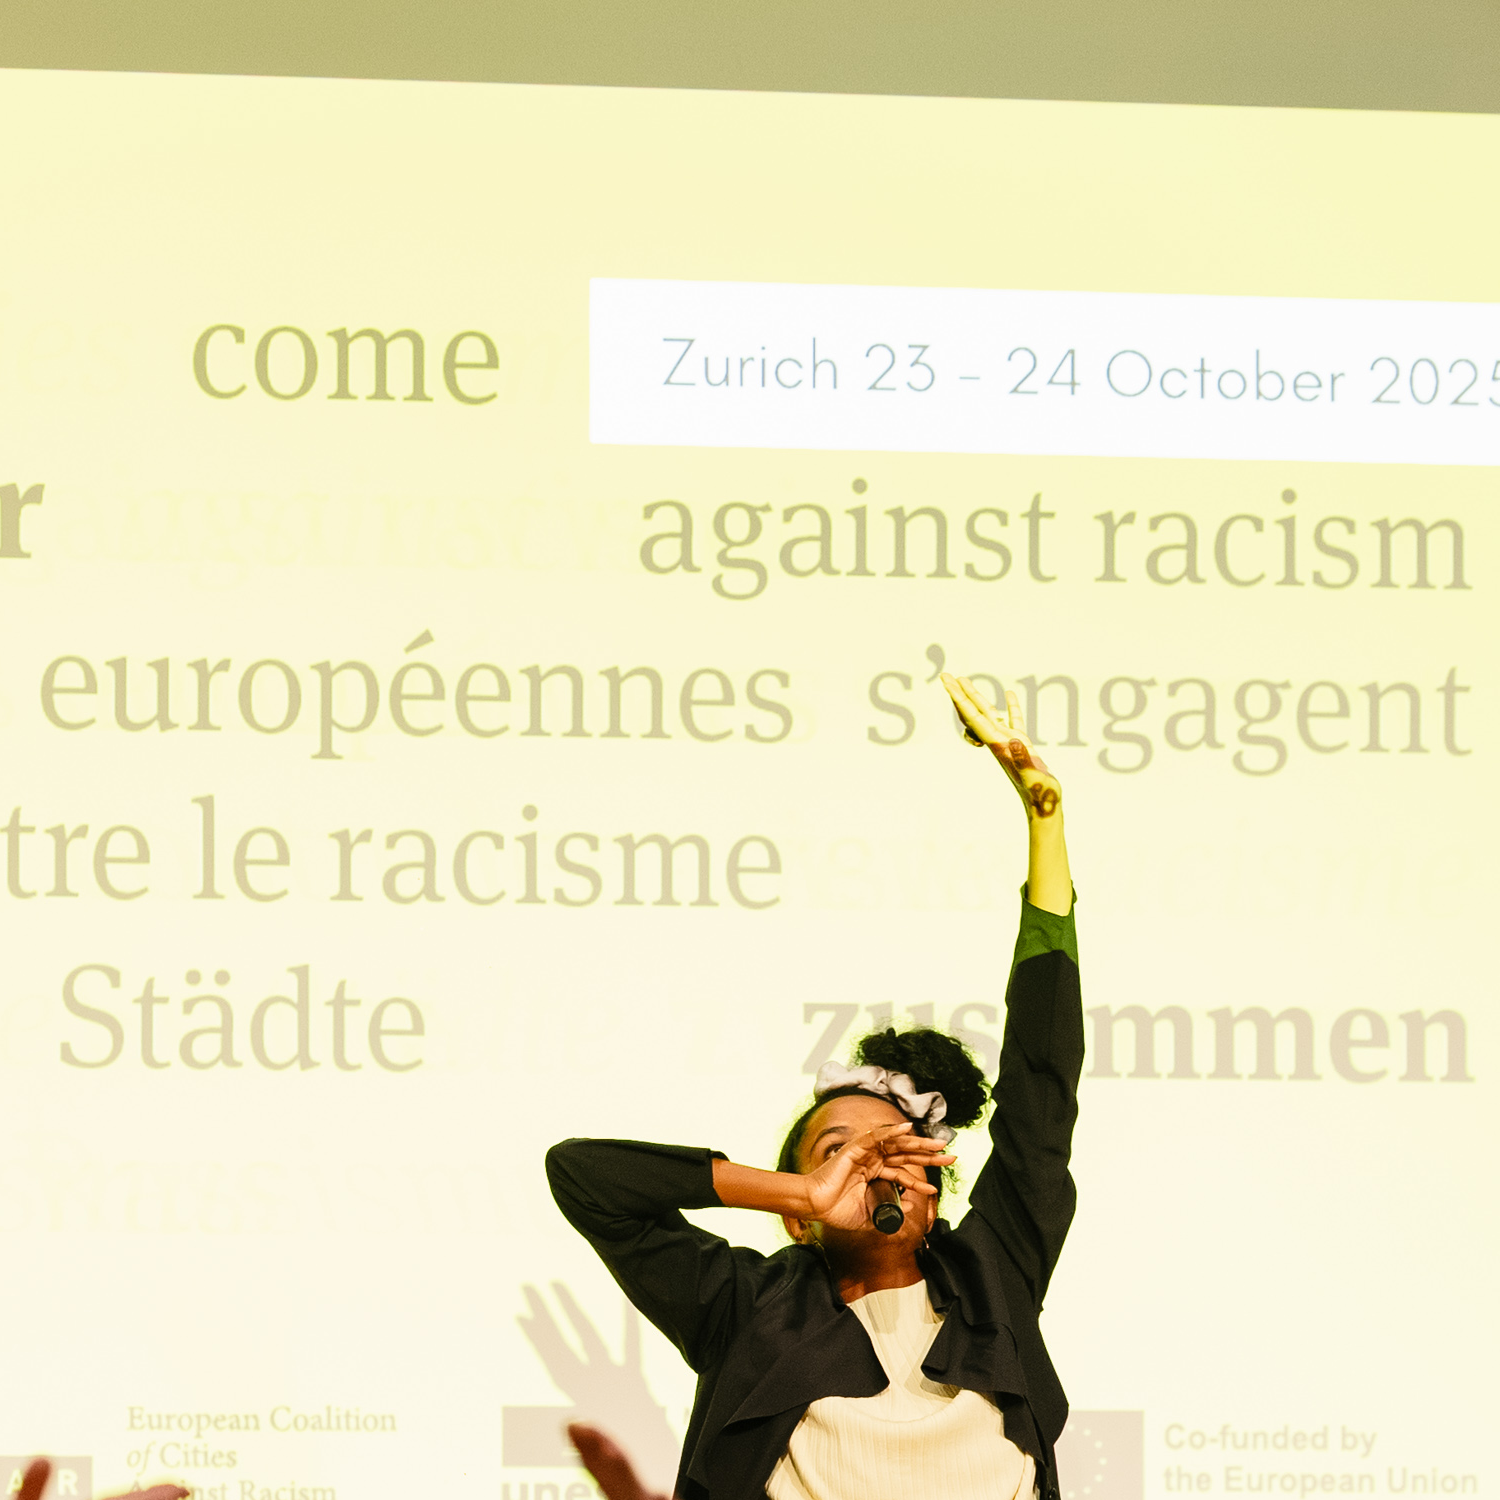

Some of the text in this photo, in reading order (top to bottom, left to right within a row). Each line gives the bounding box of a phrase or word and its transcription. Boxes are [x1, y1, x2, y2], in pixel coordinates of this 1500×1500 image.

[193, 324, 499, 405] come
[664, 338, 838, 389] Zurich
[866, 343, 936, 392] 23
[1008, 347, 1079, 395] 24
[1106, 349, 1345, 402] October
[640, 478, 1056, 601] against
[1094, 488, 1471, 590] racism
[41, 629, 793, 760] européennes
[192, 794, 290, 902] le
[329, 804, 782, 910] racisme
[60, 964, 425, 1072] Städte
[803, 1001, 1475, 1083] zsmmen
[127, 1405, 396, 1439] European Coalition
[1164, 1423, 1377, 1458] Co-funded by
[127, 1441, 237, 1477] of Cities
[1164, 1466, 1478, 1499] the European Union
